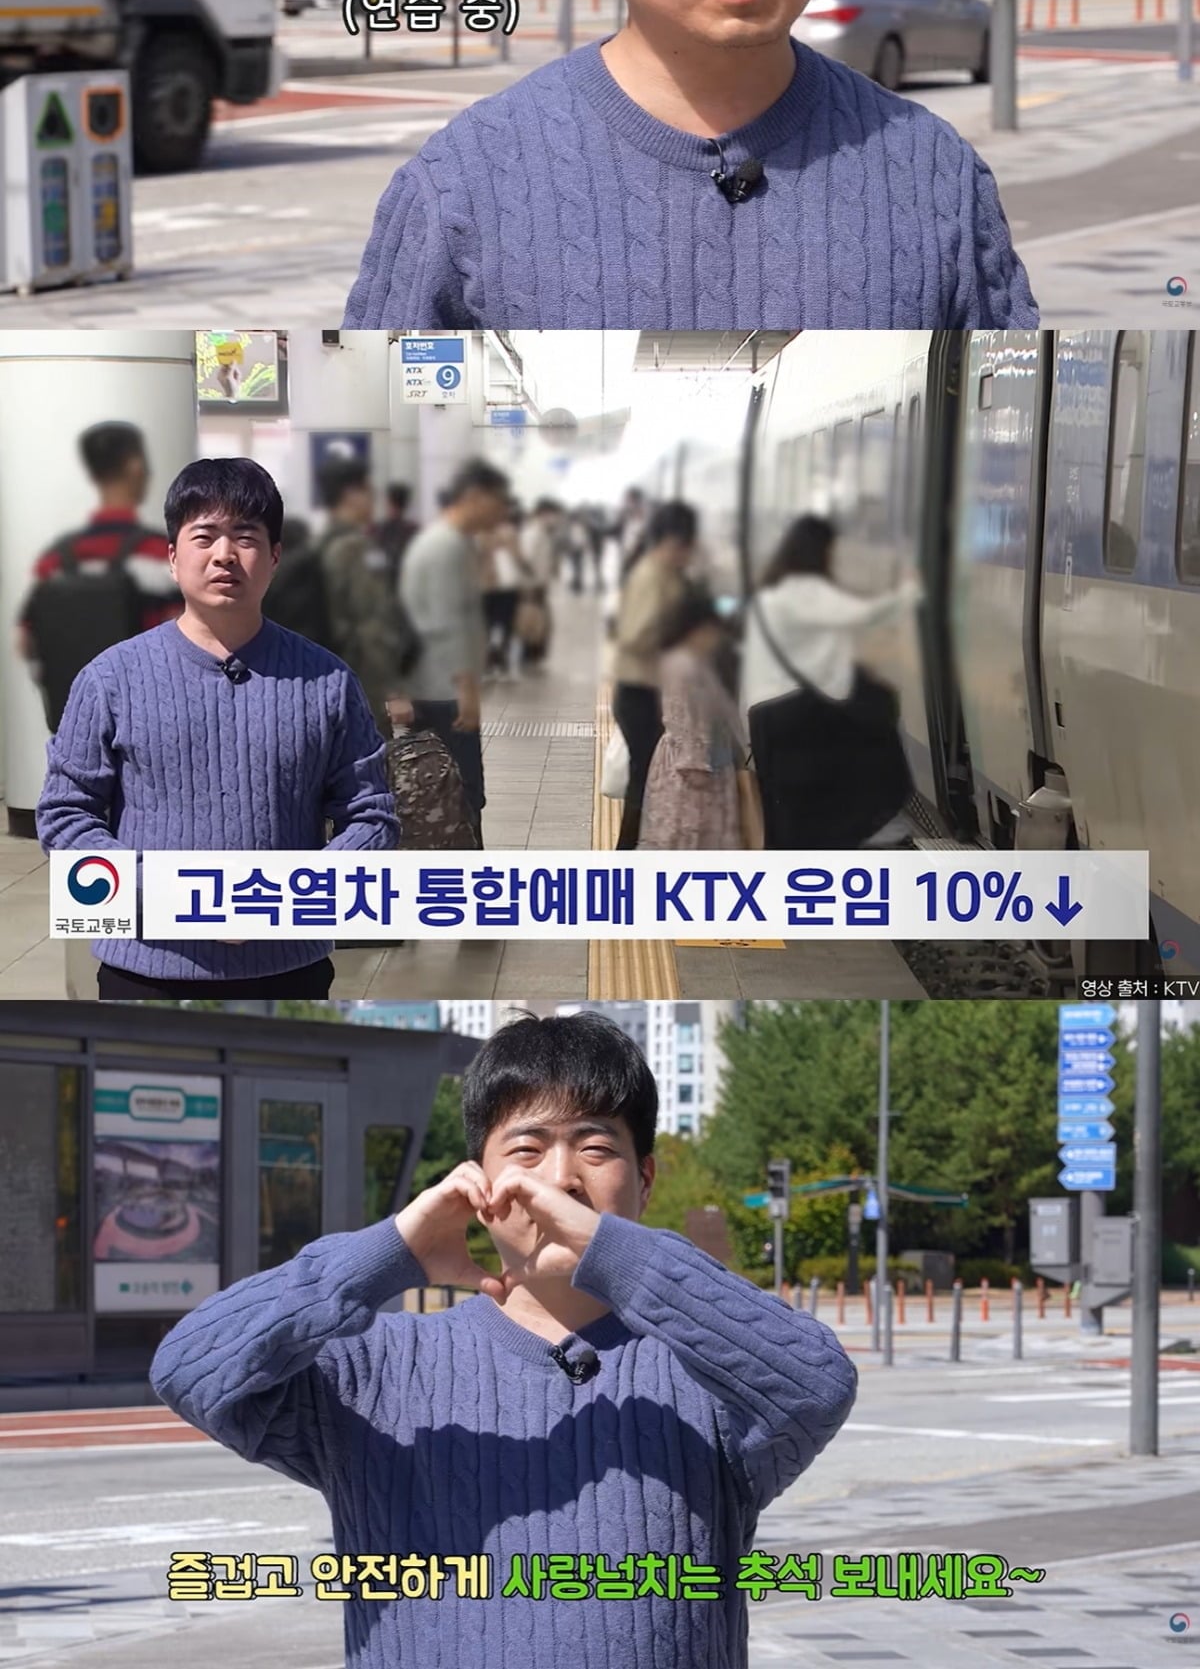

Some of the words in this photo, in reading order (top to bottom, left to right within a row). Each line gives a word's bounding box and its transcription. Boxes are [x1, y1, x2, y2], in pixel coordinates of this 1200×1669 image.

[406, 366, 423, 374] KTX
[442, 368, 455, 387] 9
[406, 390, 428, 398] SRT
